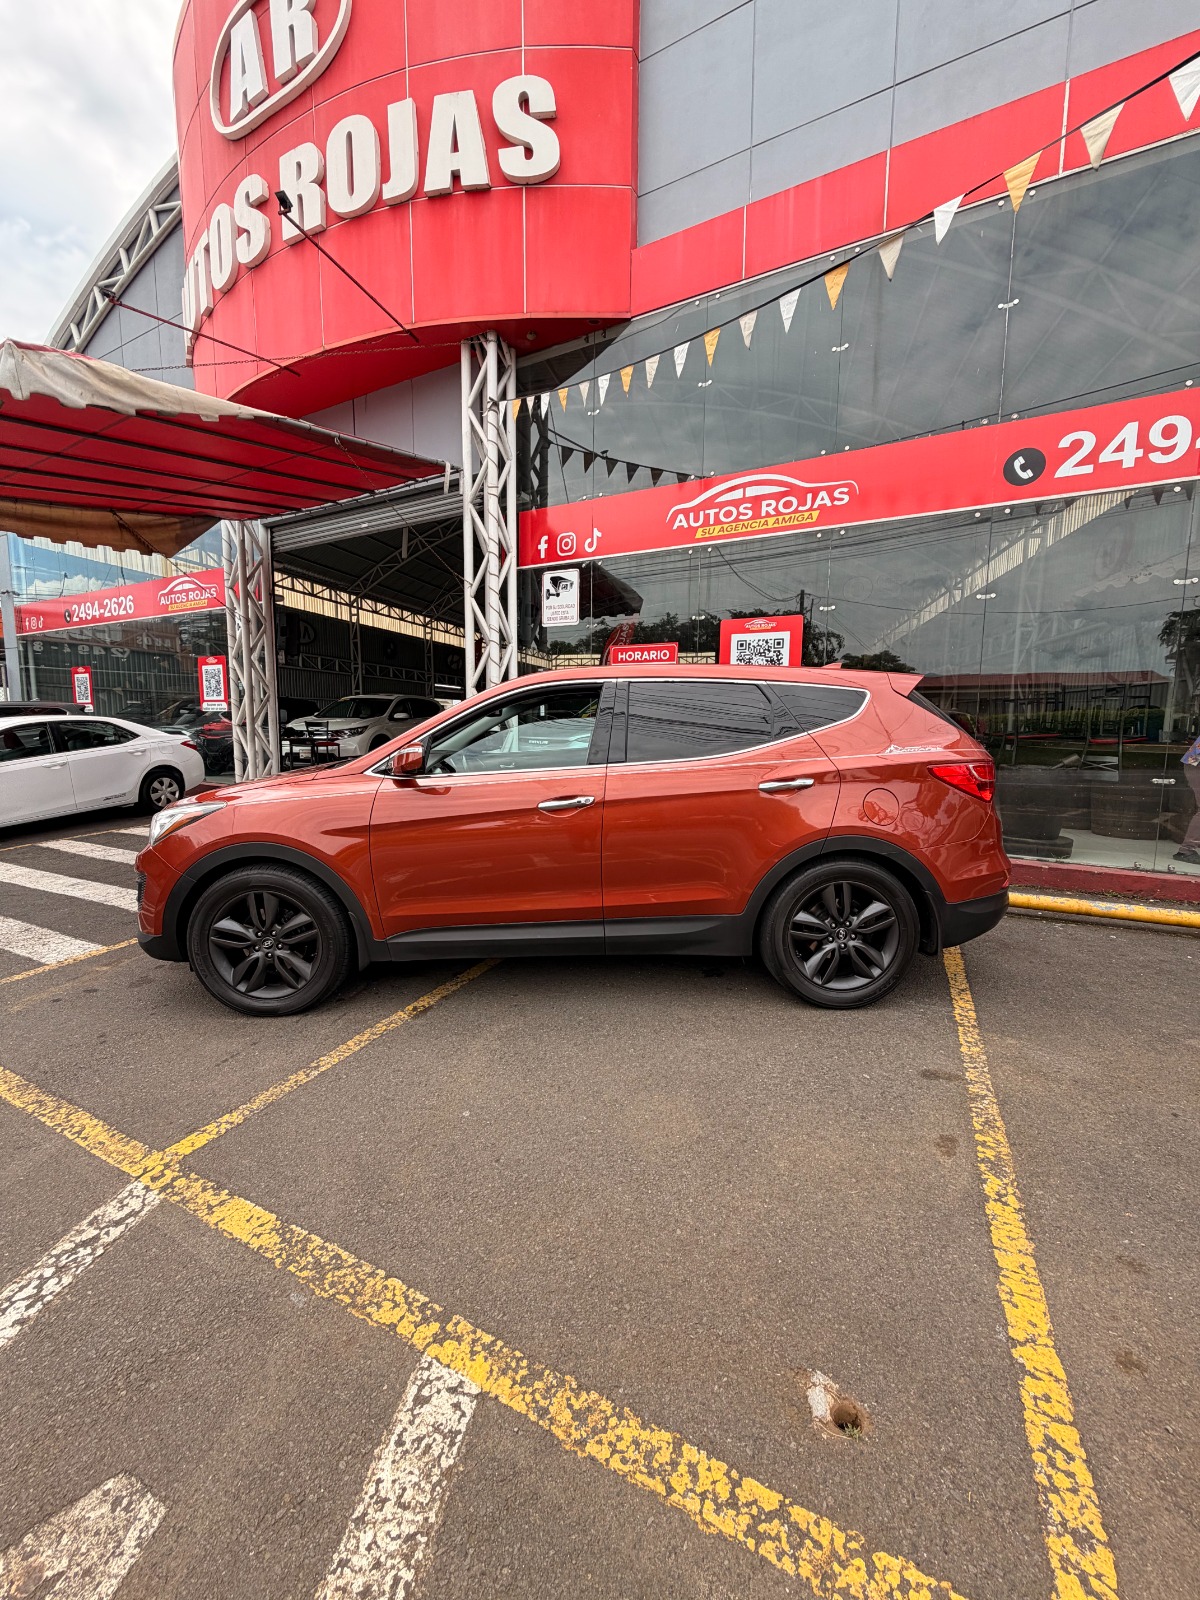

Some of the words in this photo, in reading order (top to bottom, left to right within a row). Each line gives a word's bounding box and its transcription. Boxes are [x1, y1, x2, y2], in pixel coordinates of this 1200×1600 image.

[229, 0, 319, 124] AR
[279, 74, 561, 246] ROJAS
[1054, 414, 1200, 479] 249
[672, 503, 753, 530] AUTOS
[761, 487, 850, 517] ROJAS
[700, 527, 715, 537] SU
[717, 519, 769, 534] AGENCIA
[772, 512, 814, 526] AMIGA
[72, 595, 134, 622] 2494-2626
[160, 592, 187, 605] AUTOS
[188, 588, 217, 600] ROJAS
[618, 649, 670, 662] HORARIO
